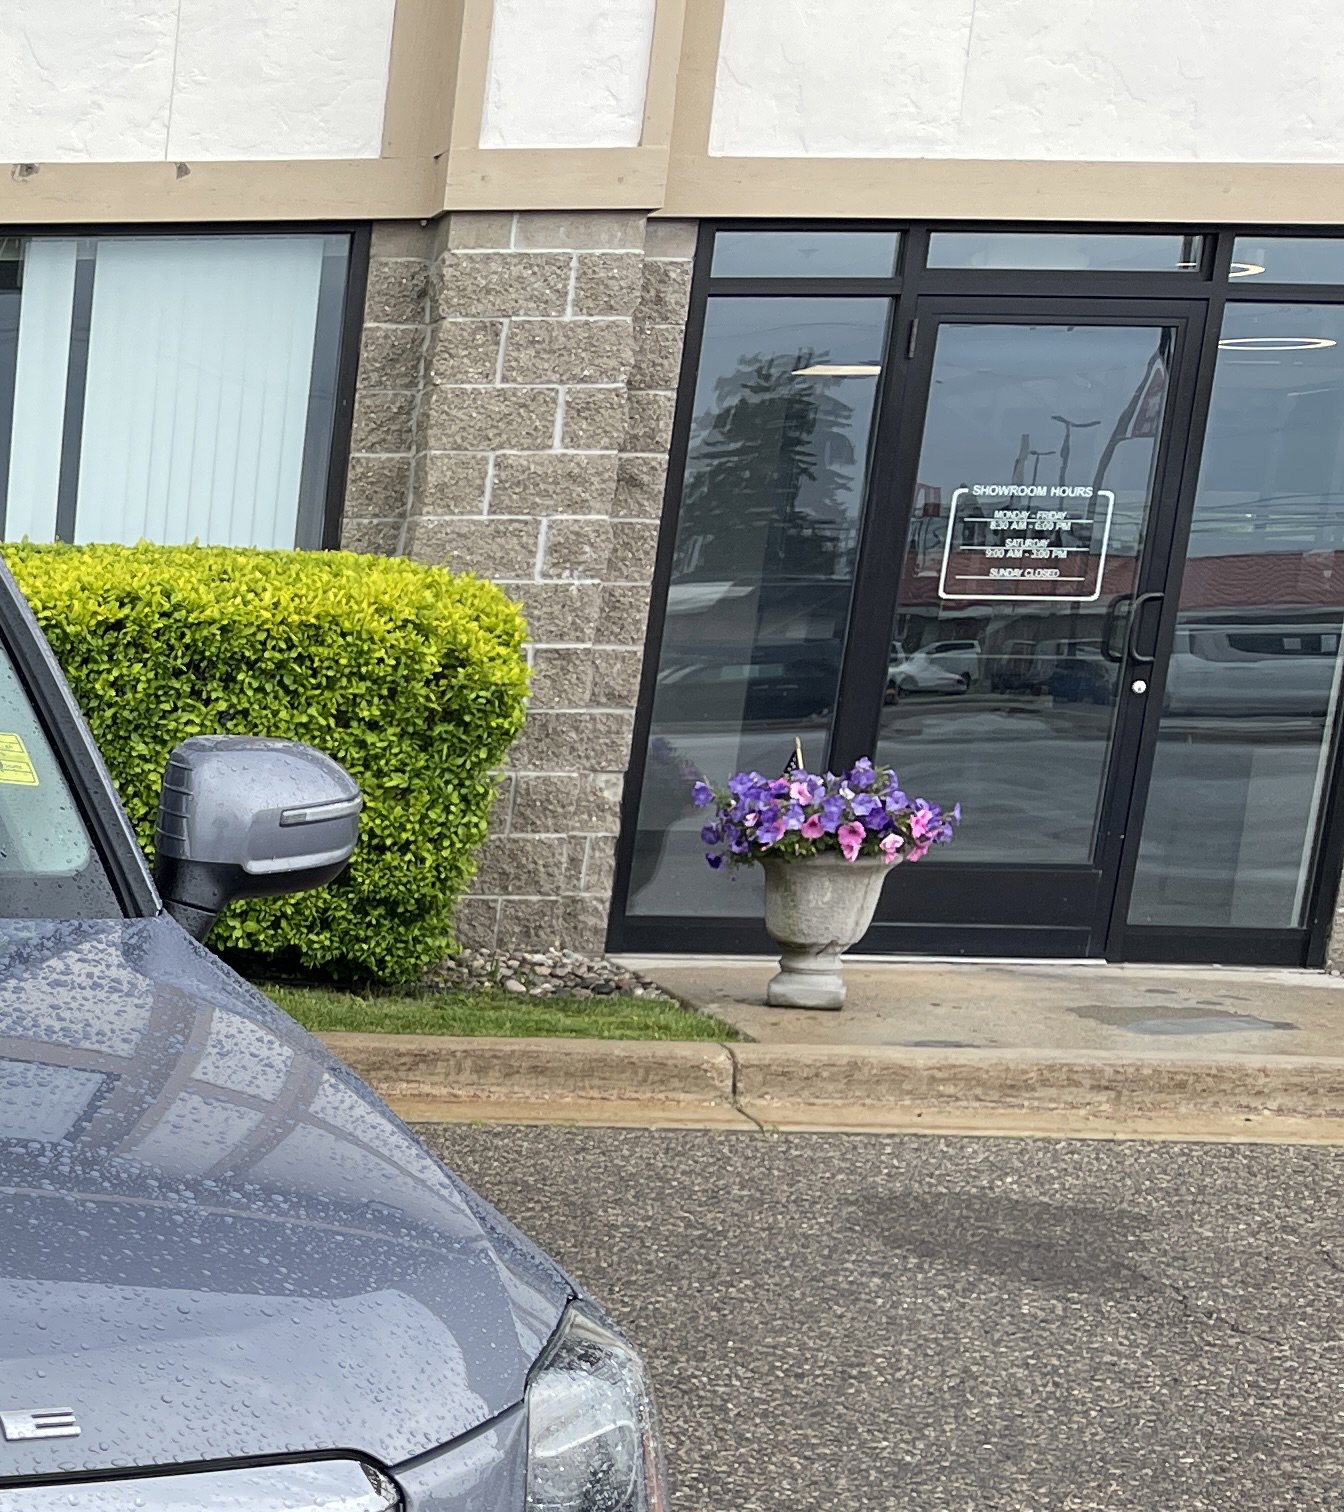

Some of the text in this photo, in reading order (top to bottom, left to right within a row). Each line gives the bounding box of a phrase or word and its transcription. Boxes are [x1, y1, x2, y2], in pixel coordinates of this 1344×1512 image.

[972, 484, 1094, 498] SHOWROOM HOURS
[993, 510, 1030, 520] MONDAY
[1036, 510, 1068, 520] FRIDAY
[1011, 520, 1027, 530] AM
[1055, 521, 1072, 531] PM
[1005, 538, 1050, 548] SATURDAY
[1006, 548, 1023, 558] AM
[1052, 549, 1068, 559] PM
[989, 567, 1060, 578] SUNDAY CLOSED
